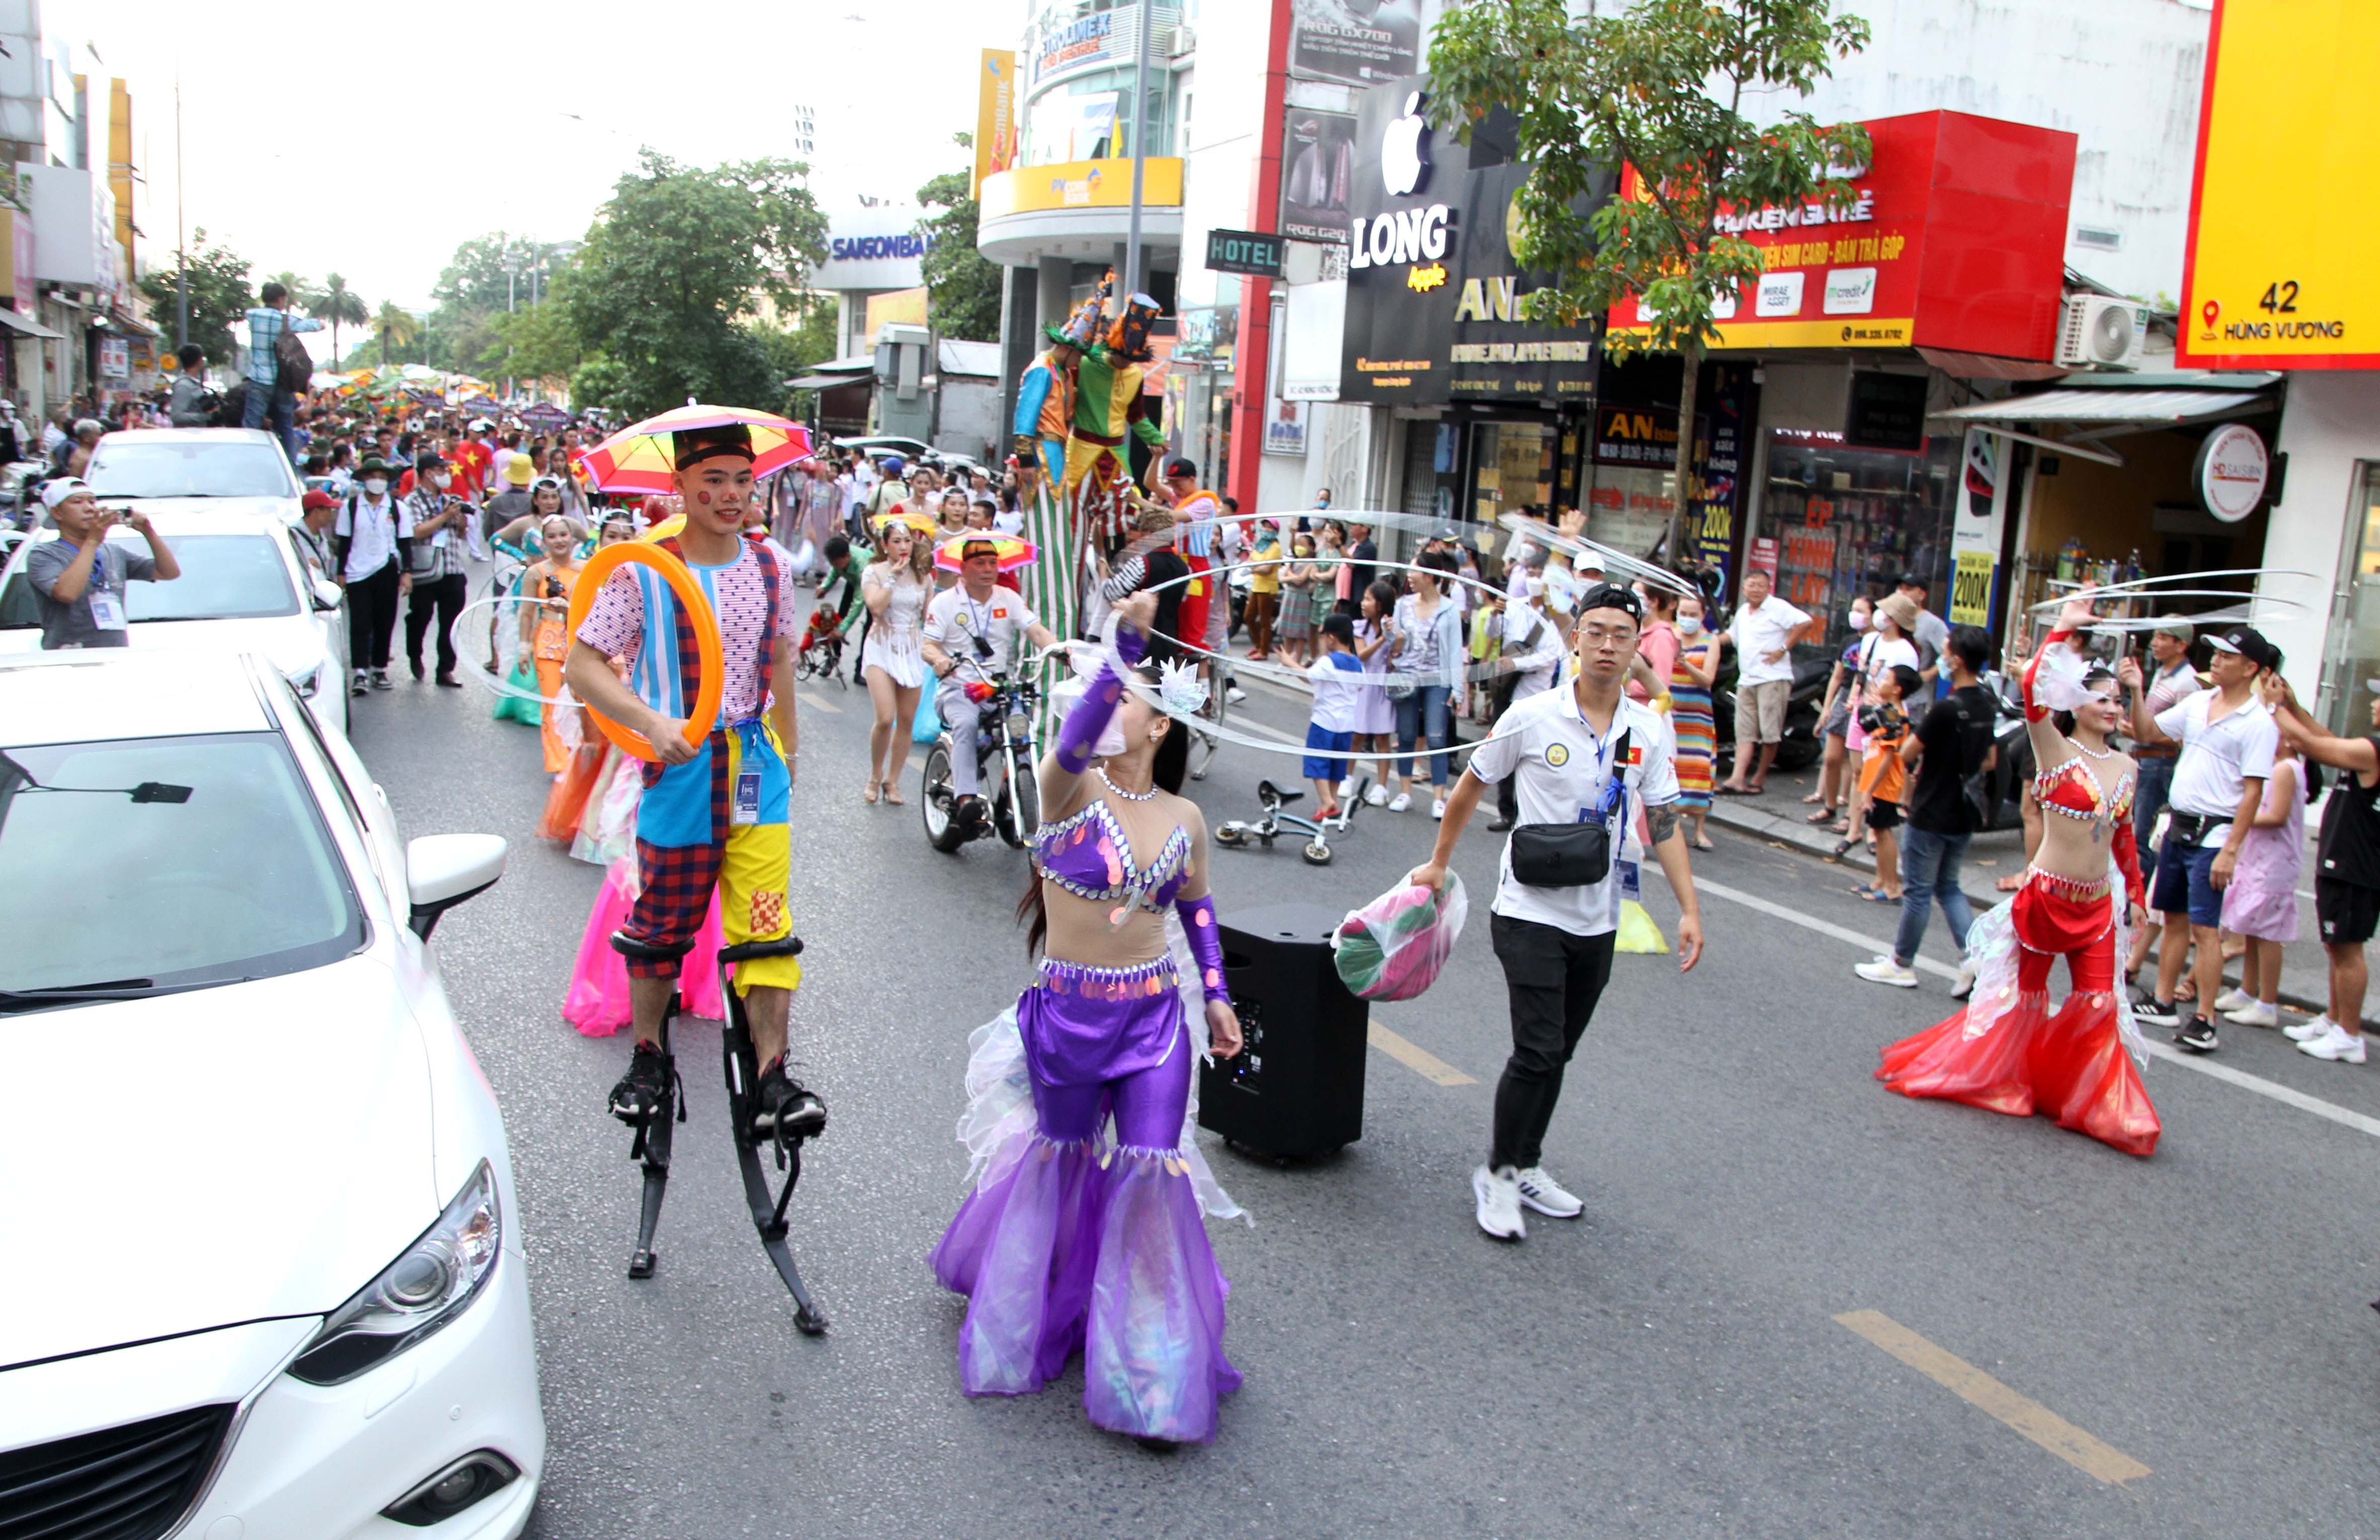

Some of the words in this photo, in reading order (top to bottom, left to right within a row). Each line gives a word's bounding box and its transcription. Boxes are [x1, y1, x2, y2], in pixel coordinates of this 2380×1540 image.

[1350, 203, 1448, 269] LONG
[1211, 237, 1279, 267] HOTEL
[1407, 262, 1446, 293] Apple
[1763, 285, 1789, 296] MIRAE
[2259, 280, 2299, 314] 42
[2224, 319, 2272, 340] HÙNG
[2276, 321, 2345, 340] VƯƠNG
[1607, 413, 1654, 440] AN
[1953, 570, 1991, 611] 200K
